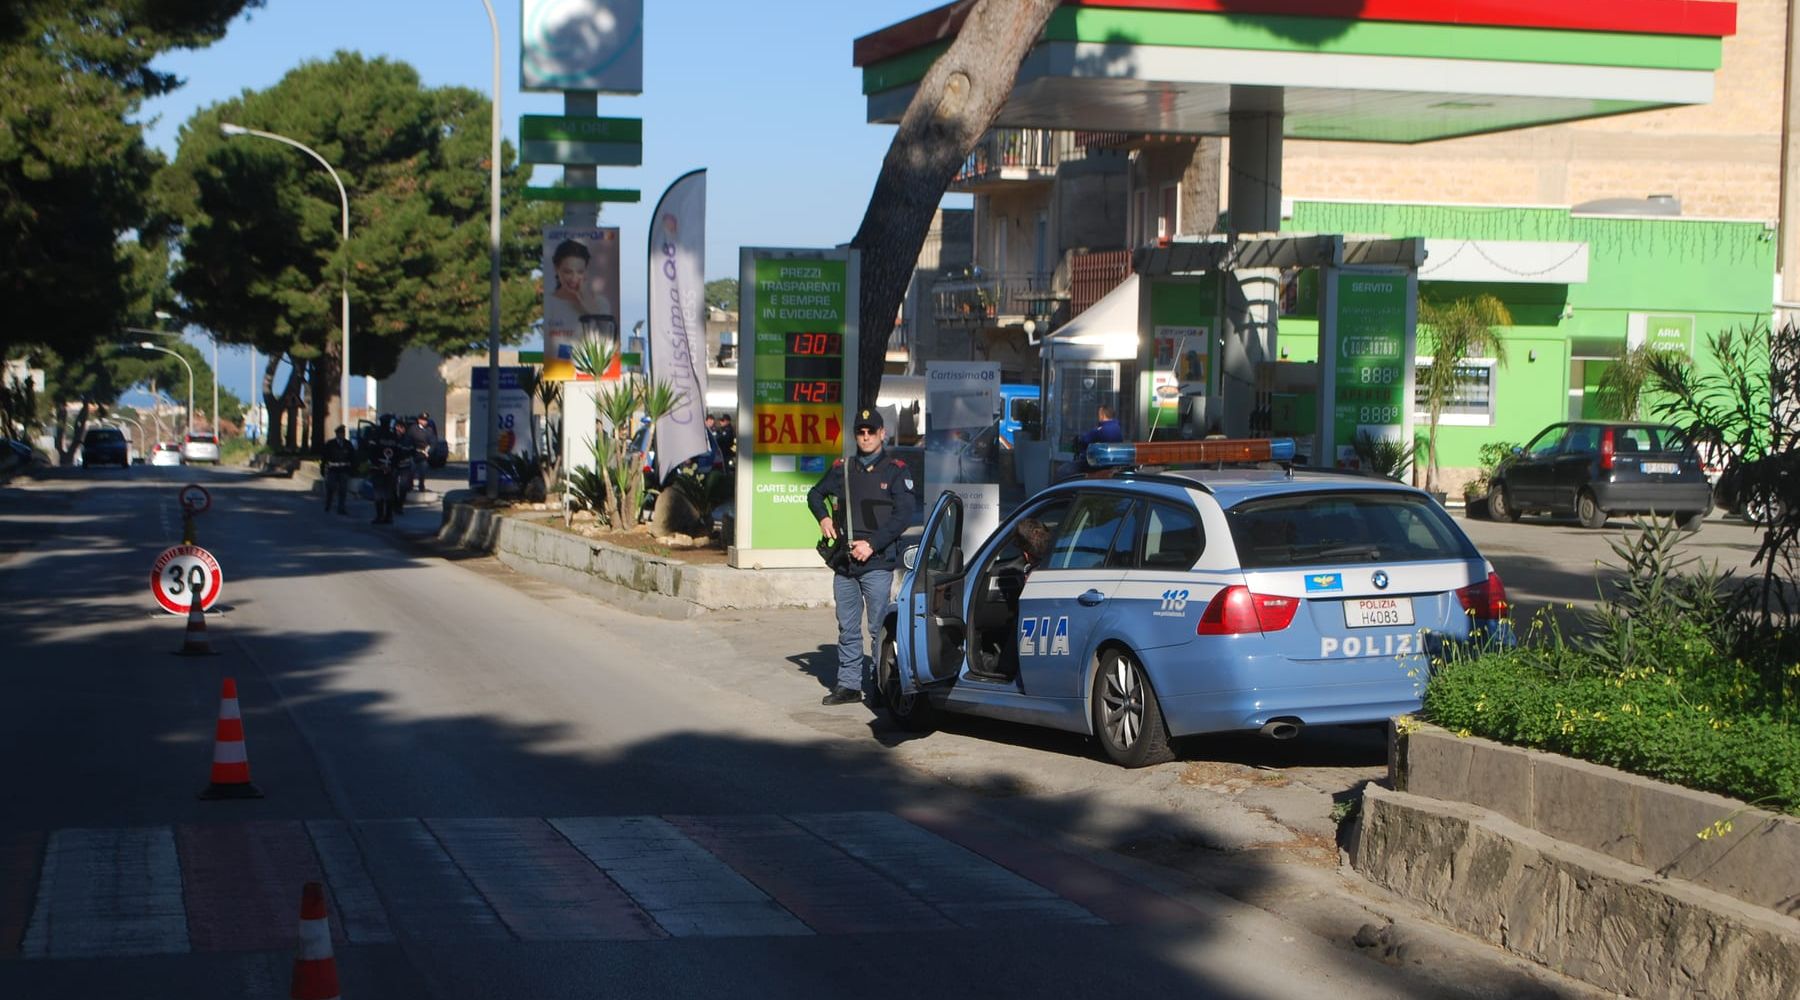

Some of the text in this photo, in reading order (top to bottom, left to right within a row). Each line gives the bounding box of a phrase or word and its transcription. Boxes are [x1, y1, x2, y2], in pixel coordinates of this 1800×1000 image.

[780, 267, 821, 278] PREZZI
[760, 281, 840, 292] TRASPARENTI
[1352, 283, 1393, 293] SERVITO
[771, 294, 831, 305] E SEMPRE
[763, 308, 838, 319] IN EVIDENZA
[1657, 328, 1680, 337] ARIA
[757, 413, 822, 444] BAR
[756, 484, 785, 493] CARTE
[788, 484, 798, 493] DI
[168, 564, 206, 596] 30
[1160, 589, 1190, 611] 113
[1359, 600, 1398, 610] POLIZIA
[1361, 610, 1399, 625] H4083
[1019, 616, 1071, 656] ZIA
[1320, 632, 1425, 658] POLIZI
